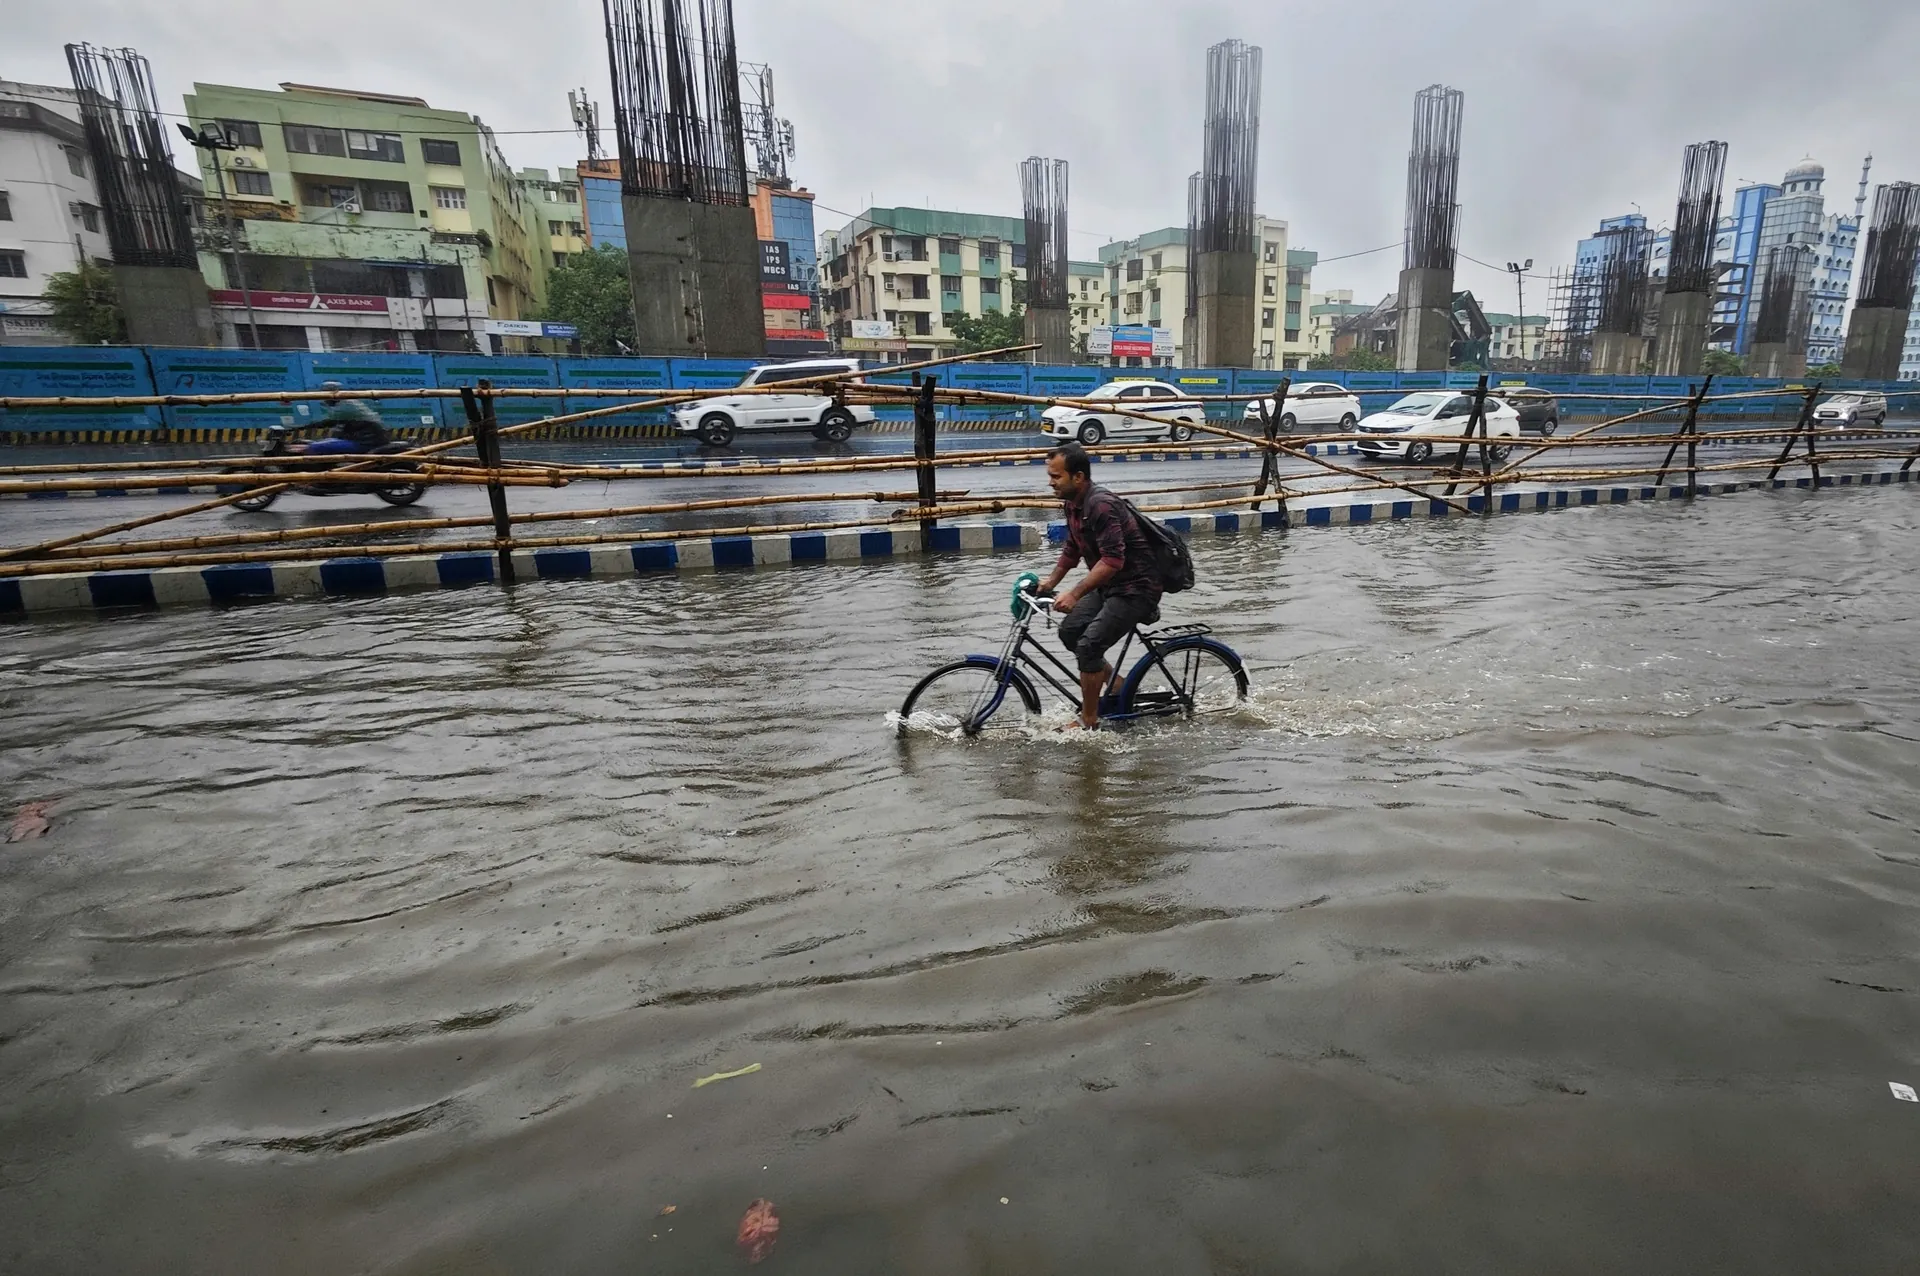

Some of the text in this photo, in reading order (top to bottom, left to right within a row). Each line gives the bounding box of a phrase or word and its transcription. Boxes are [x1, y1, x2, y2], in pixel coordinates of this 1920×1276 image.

[765, 245, 780, 254] IAS
[766, 255, 781, 264] IPS
[763, 266, 786, 275] WBCS
[4, 319, 55, 328] SKIPPE
